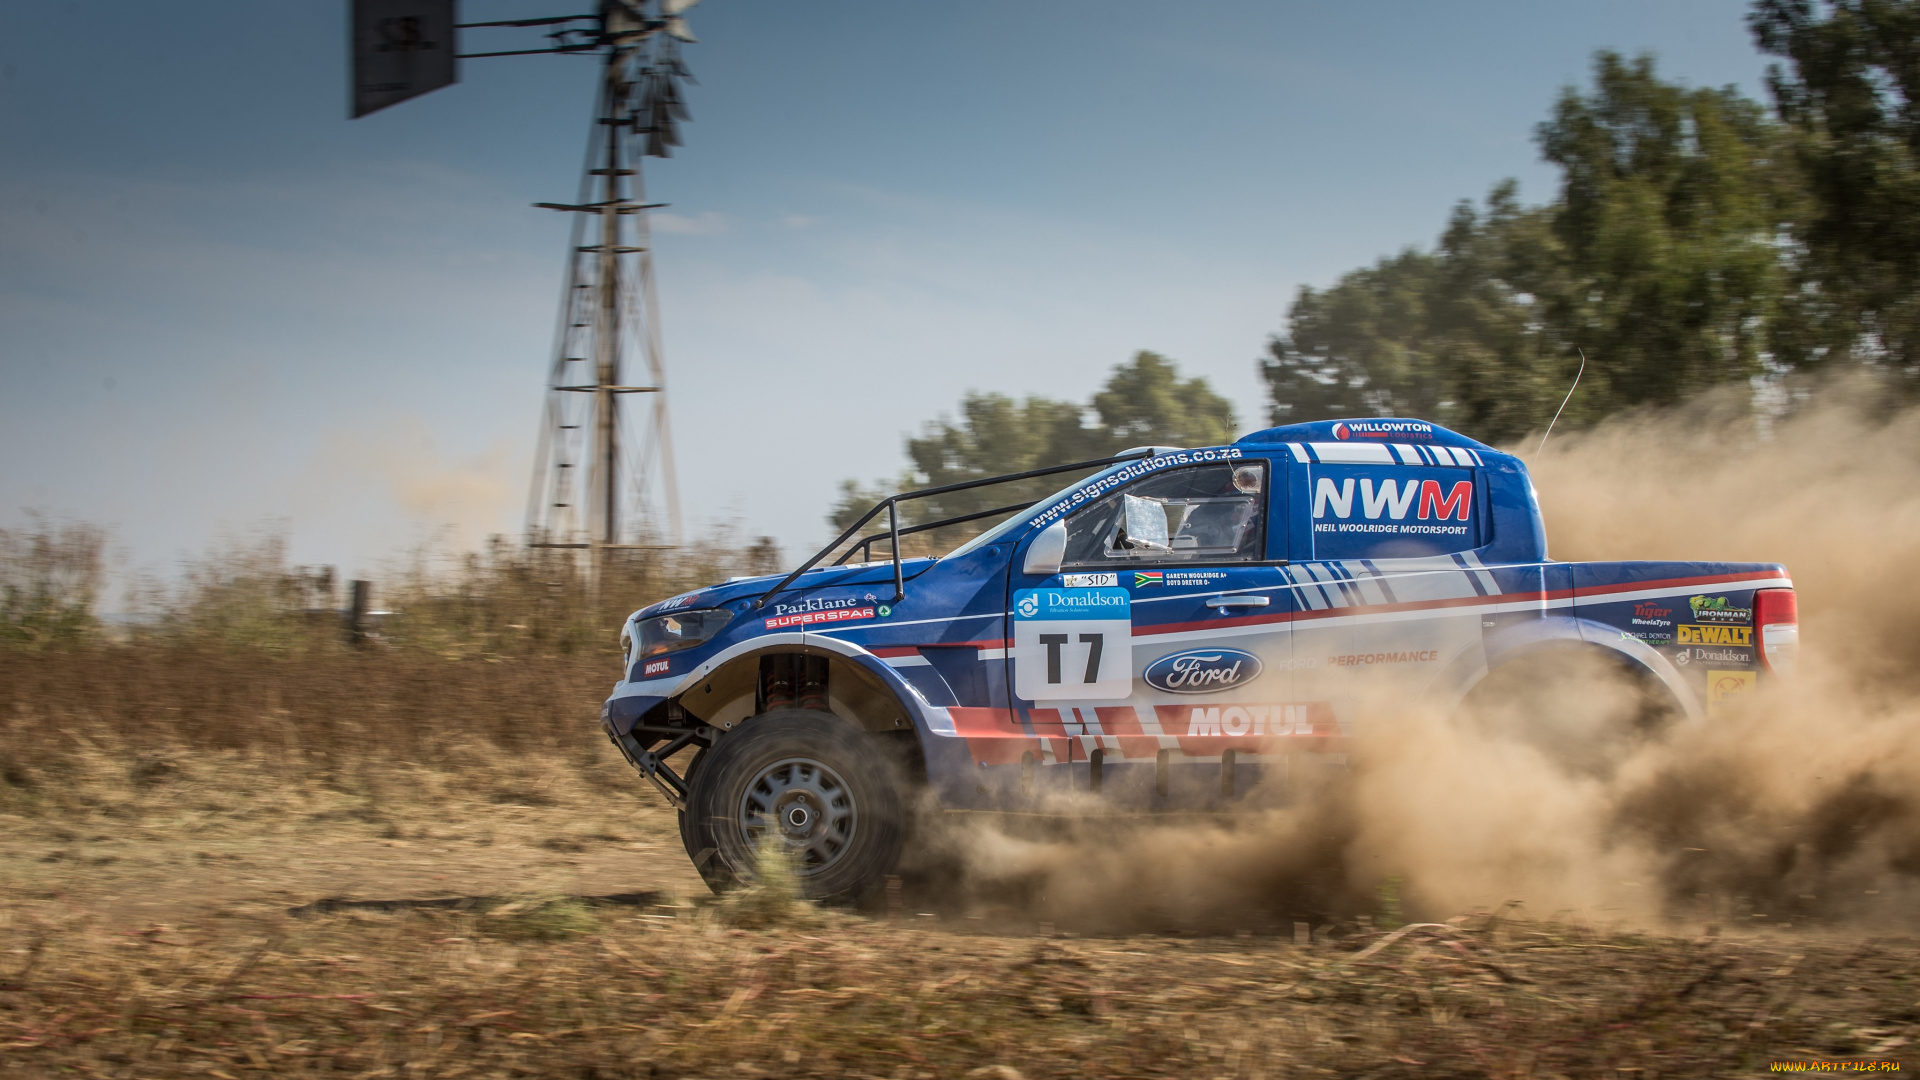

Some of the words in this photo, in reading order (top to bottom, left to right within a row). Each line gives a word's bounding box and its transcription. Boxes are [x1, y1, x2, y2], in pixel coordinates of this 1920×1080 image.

[1349, 423, 1432, 432] WILLOWTON
[1029, 448, 1242, 529] www.signsolutions.co.za
[1313, 478, 1473, 521] NWM
[1315, 523, 1337, 532] NEIL
[1338, 524, 1398, 533] WOOLRIDGE
[1400, 525, 1468, 535] MOTORSPORT
[659, 595, 700, 611] NWM
[774, 598, 857, 616] Parklane
[1633, 602, 1673, 619] Tiger
[766, 608, 874, 628] SUPERSPAR
[1698, 610, 1747, 618] IRONMAN
[1039, 633, 1104, 684] T7
[1327, 650, 1439, 667] PERFORMANCE
[645, 660, 669, 675] MOTUL
[1166, 655, 1242, 688] Ford
[1188, 705, 1314, 736] MOTUL
